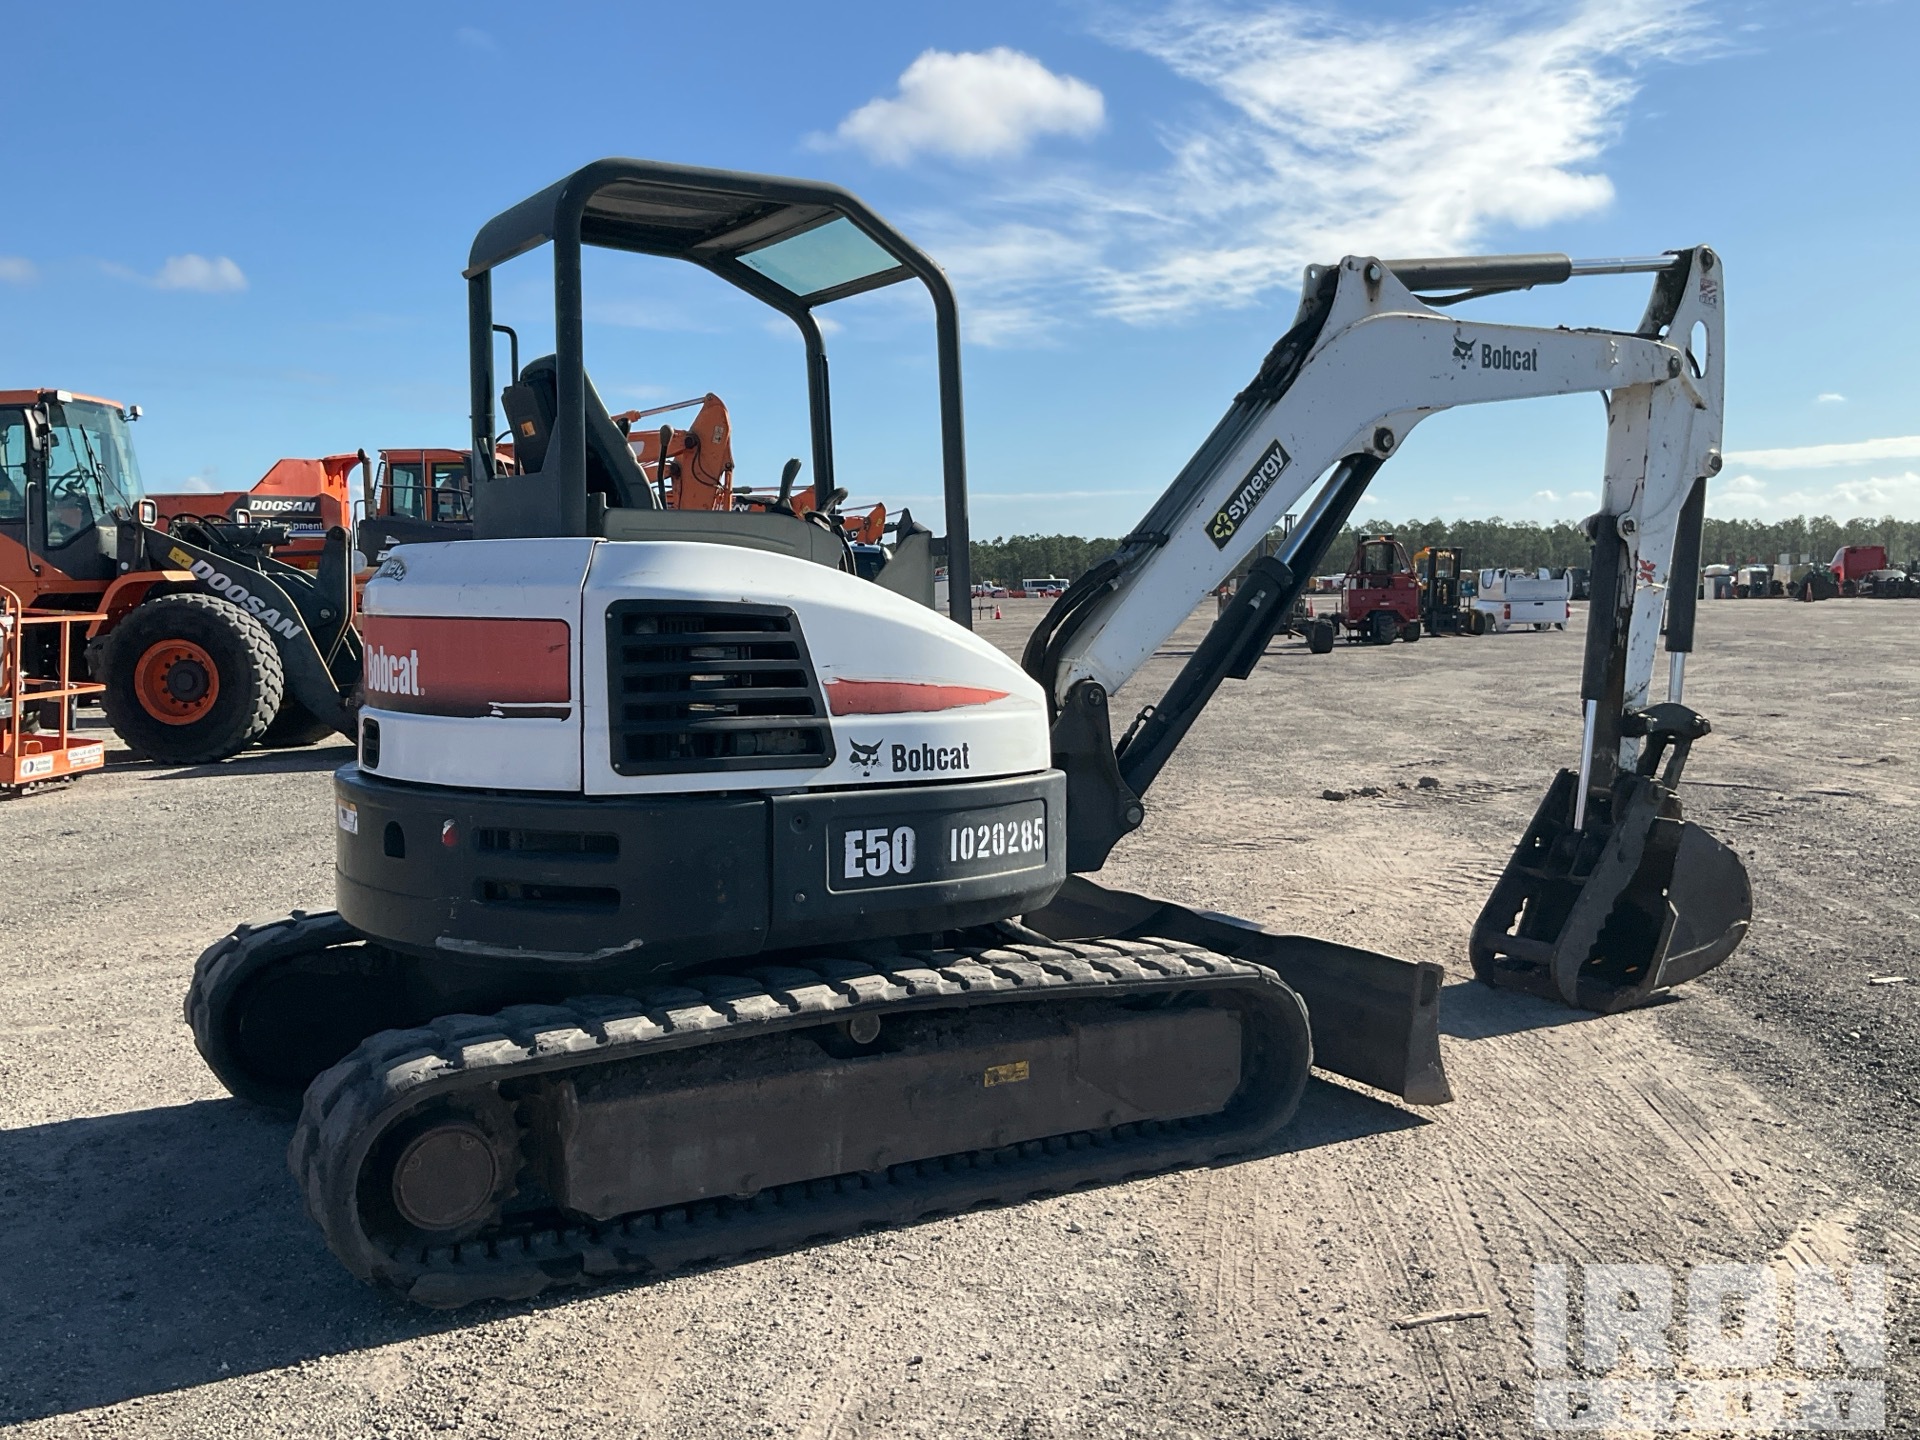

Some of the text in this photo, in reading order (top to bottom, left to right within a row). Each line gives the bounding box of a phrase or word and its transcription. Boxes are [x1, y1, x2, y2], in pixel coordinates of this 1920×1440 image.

[1481, 343, 1538, 372] Bobcat
[249, 500, 316, 512] DOOSAN
[1228, 447, 1284, 520] synergy
[190, 559, 303, 640] DOOSAN
[366, 645, 419, 696] Bobcat
[891, 742, 970, 773] Bobcat
[844, 825, 916, 879] E50
